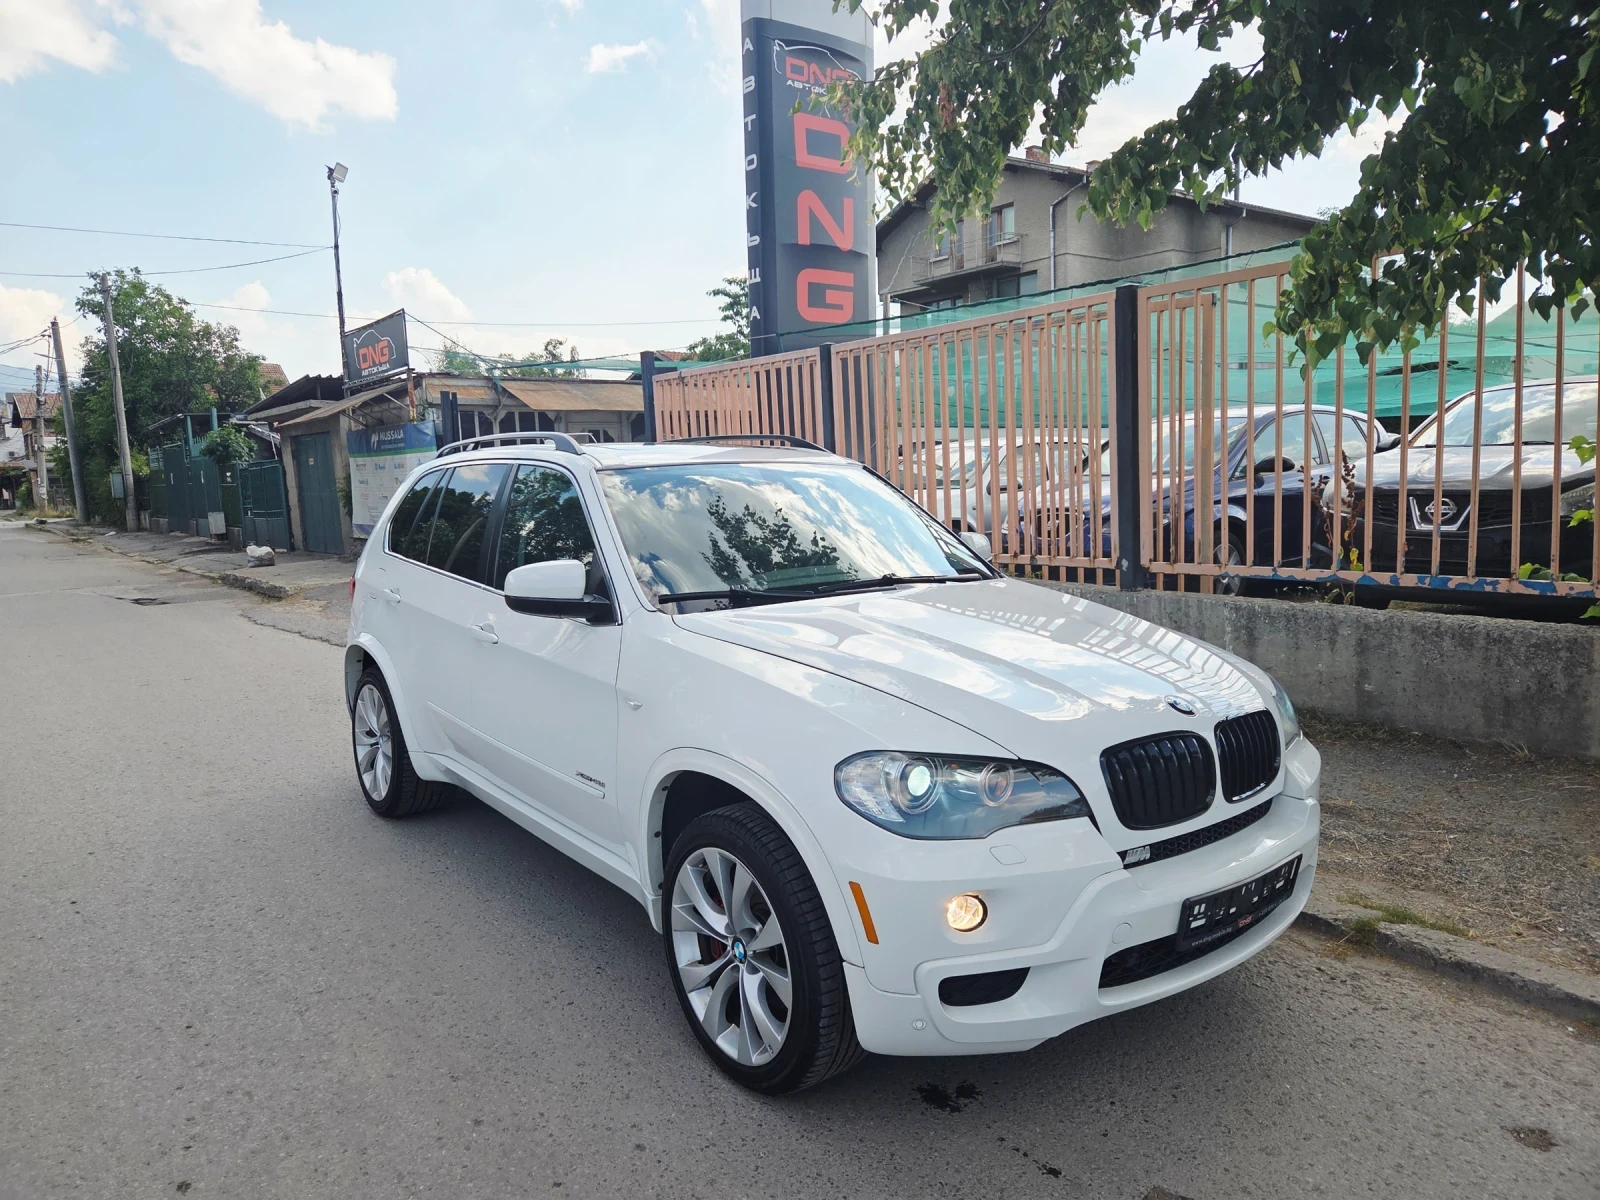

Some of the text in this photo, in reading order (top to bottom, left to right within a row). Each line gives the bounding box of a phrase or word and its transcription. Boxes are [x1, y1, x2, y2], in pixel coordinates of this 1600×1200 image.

[794, 112, 854, 323] DNG
[359, 340, 389, 369] DNG
[379, 429, 404, 441] MUSSALA
